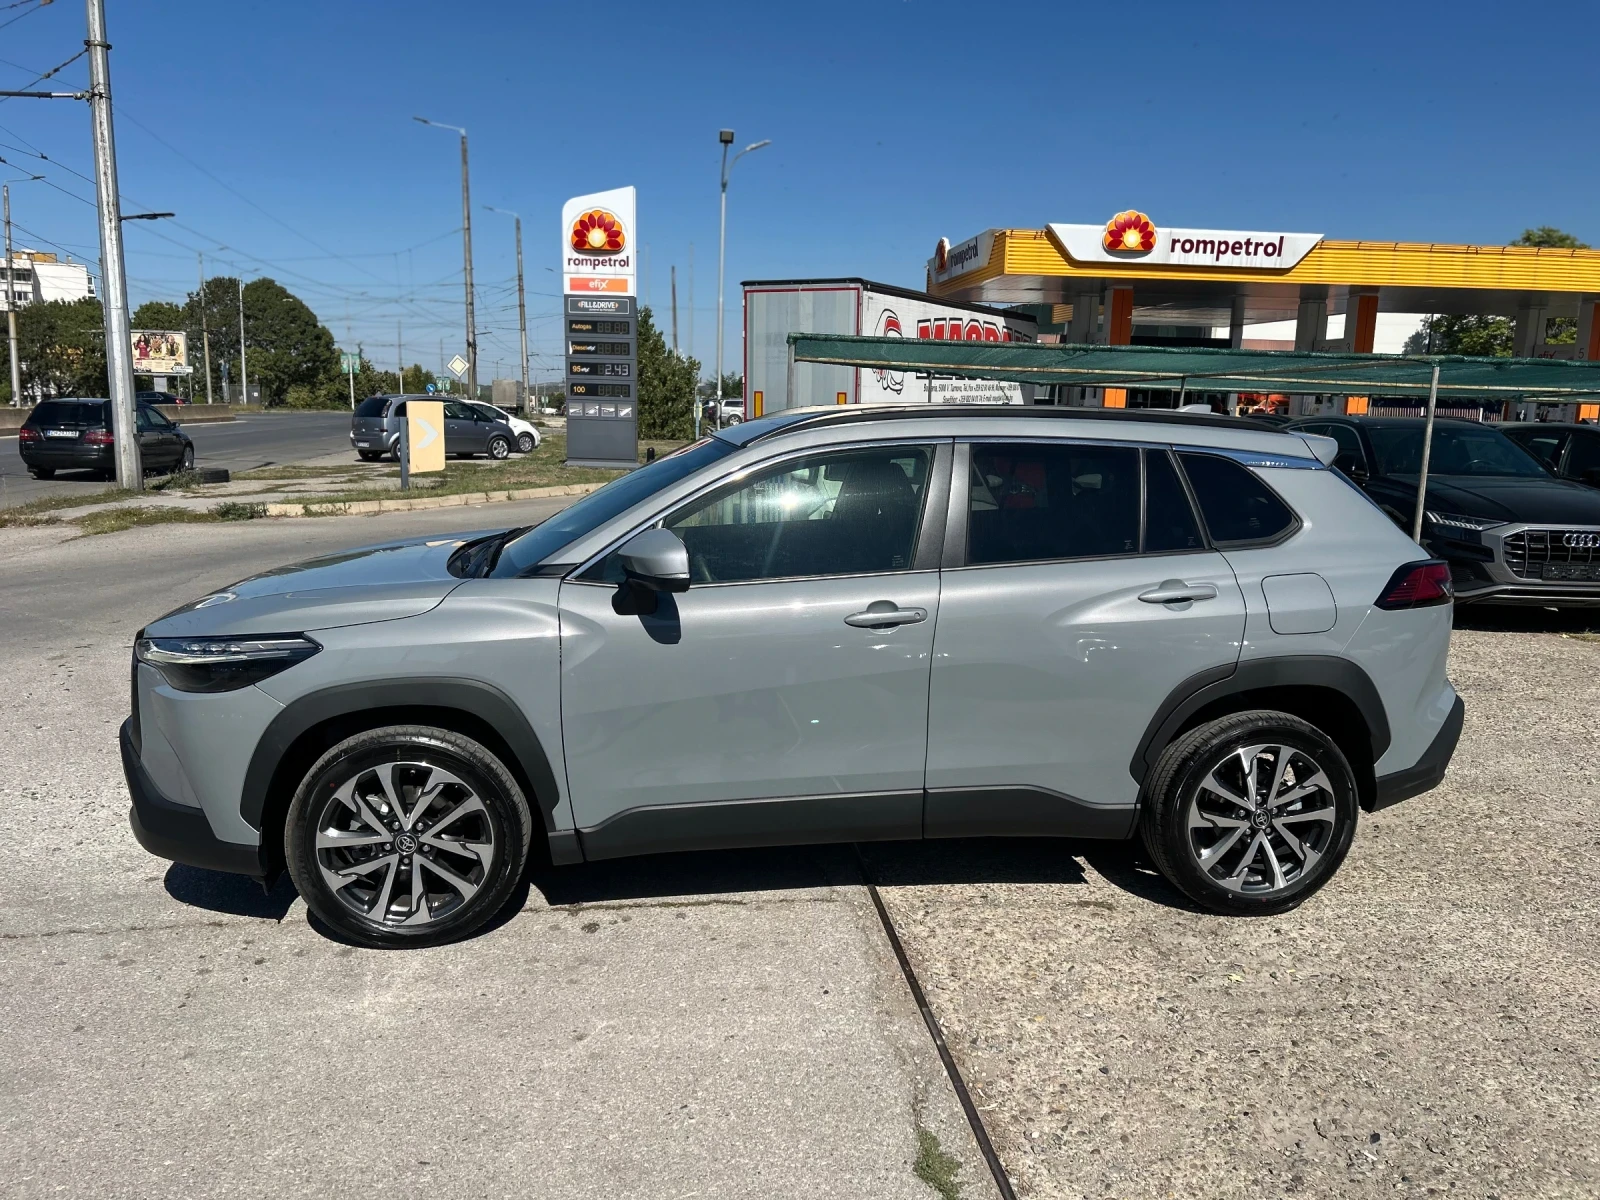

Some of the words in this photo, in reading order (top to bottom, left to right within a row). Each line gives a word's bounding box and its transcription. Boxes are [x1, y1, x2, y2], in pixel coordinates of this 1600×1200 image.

[951, 236, 978, 269] rompetrol
[1170, 236, 1284, 261] rompetrol
[567, 255, 629, 270] rompetrol
[588, 279, 609, 290] efix
[1578, 347, 1585, 360] 5
[572, 365, 581, 373] 95
[605, 364, 629, 376] 2.43
